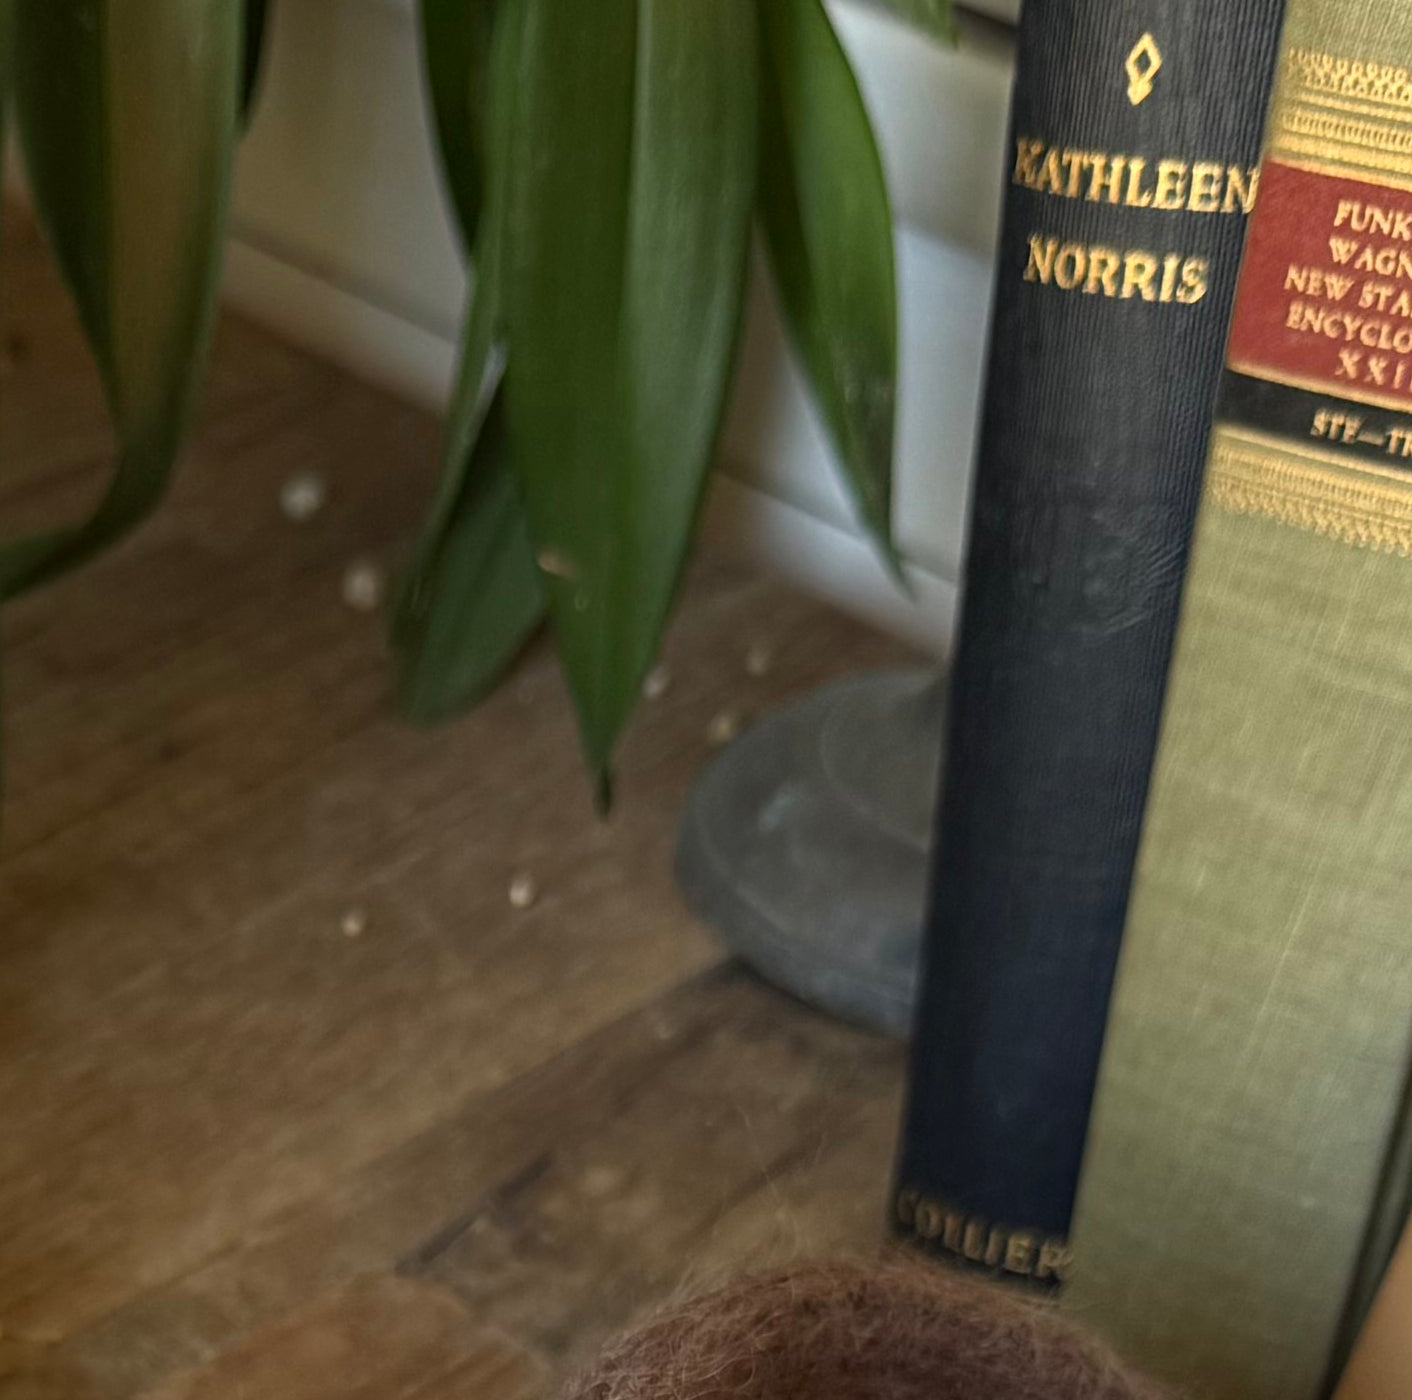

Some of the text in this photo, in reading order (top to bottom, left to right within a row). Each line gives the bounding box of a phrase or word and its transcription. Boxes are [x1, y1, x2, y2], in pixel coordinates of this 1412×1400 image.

[1012, 136, 1259, 215] KATHLEEN
[1334, 199, 1412, 241] FUNK
[1022, 233, 1209, 305] NORRIS
[1284, 263, 1412, 317] NEW STA
[1286, 299, 1412, 354] ENCYCLO
